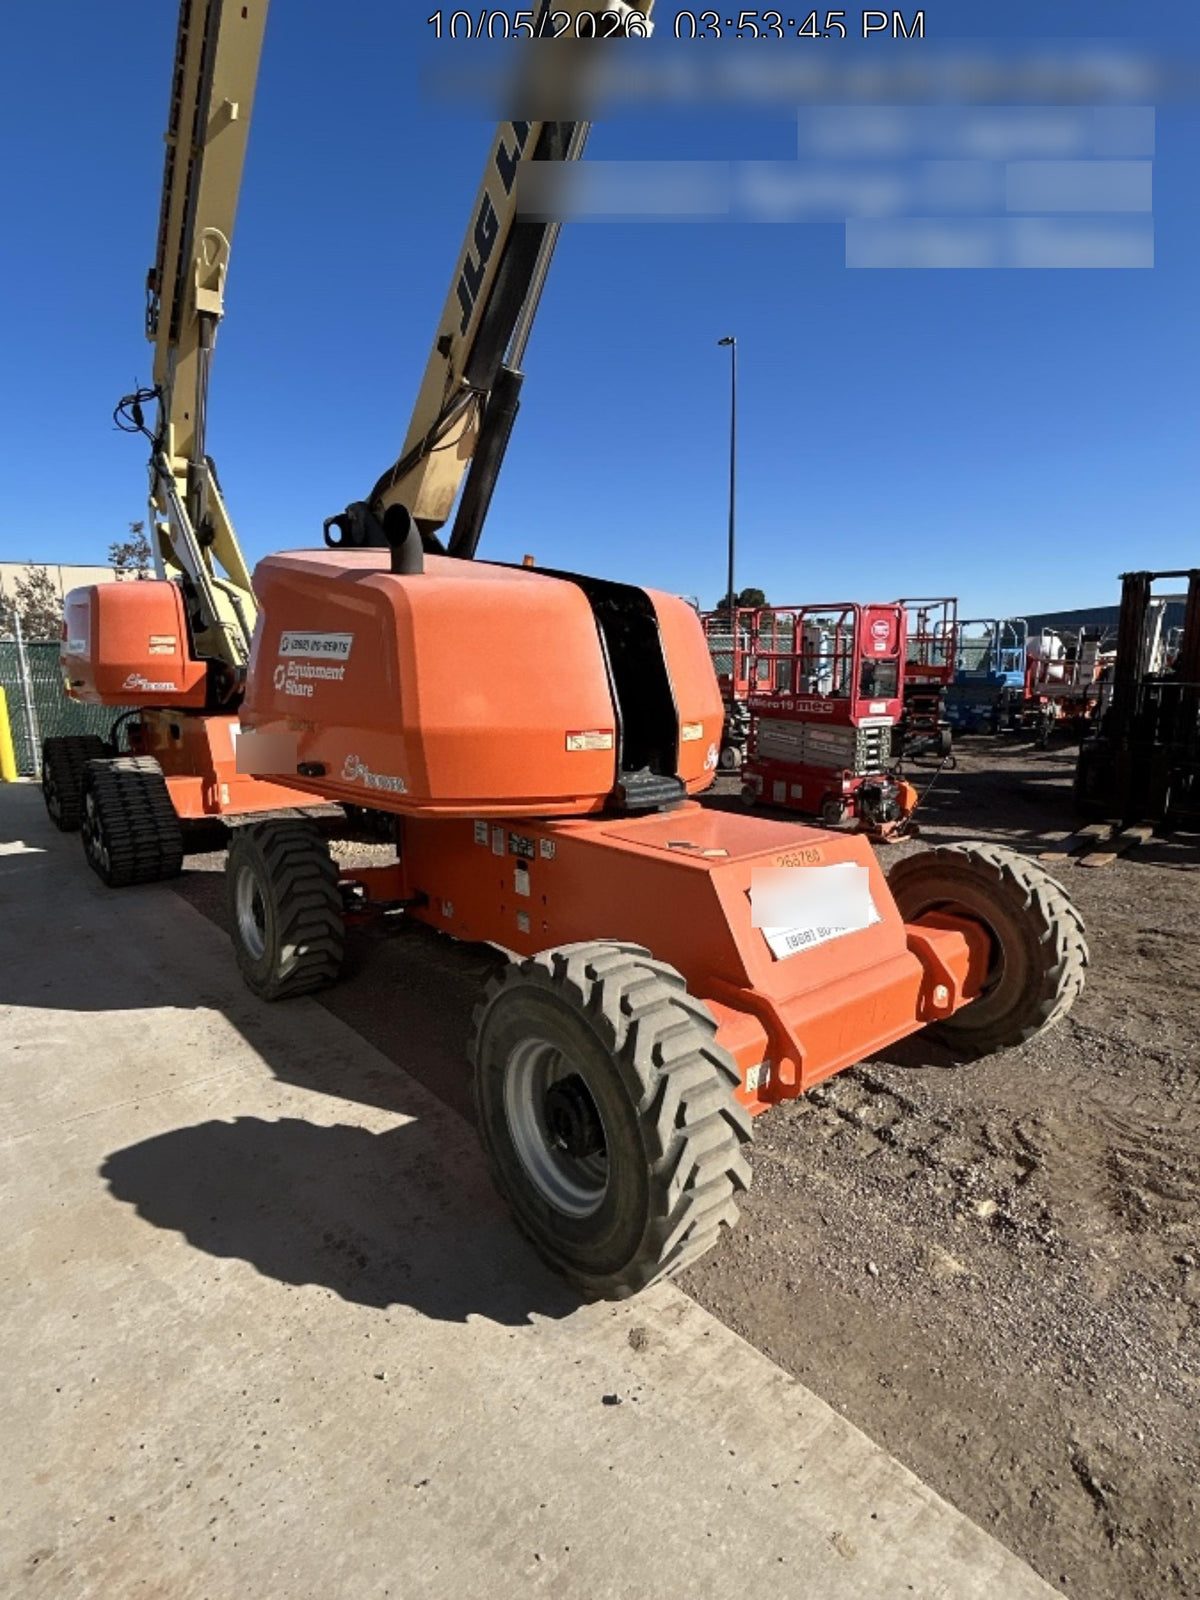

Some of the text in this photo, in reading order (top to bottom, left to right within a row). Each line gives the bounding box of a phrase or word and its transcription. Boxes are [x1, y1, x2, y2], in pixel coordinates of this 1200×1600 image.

[456, 188, 500, 337] JLG
[287, 660, 345, 681] Equipment
[285, 679, 314, 698] Share
